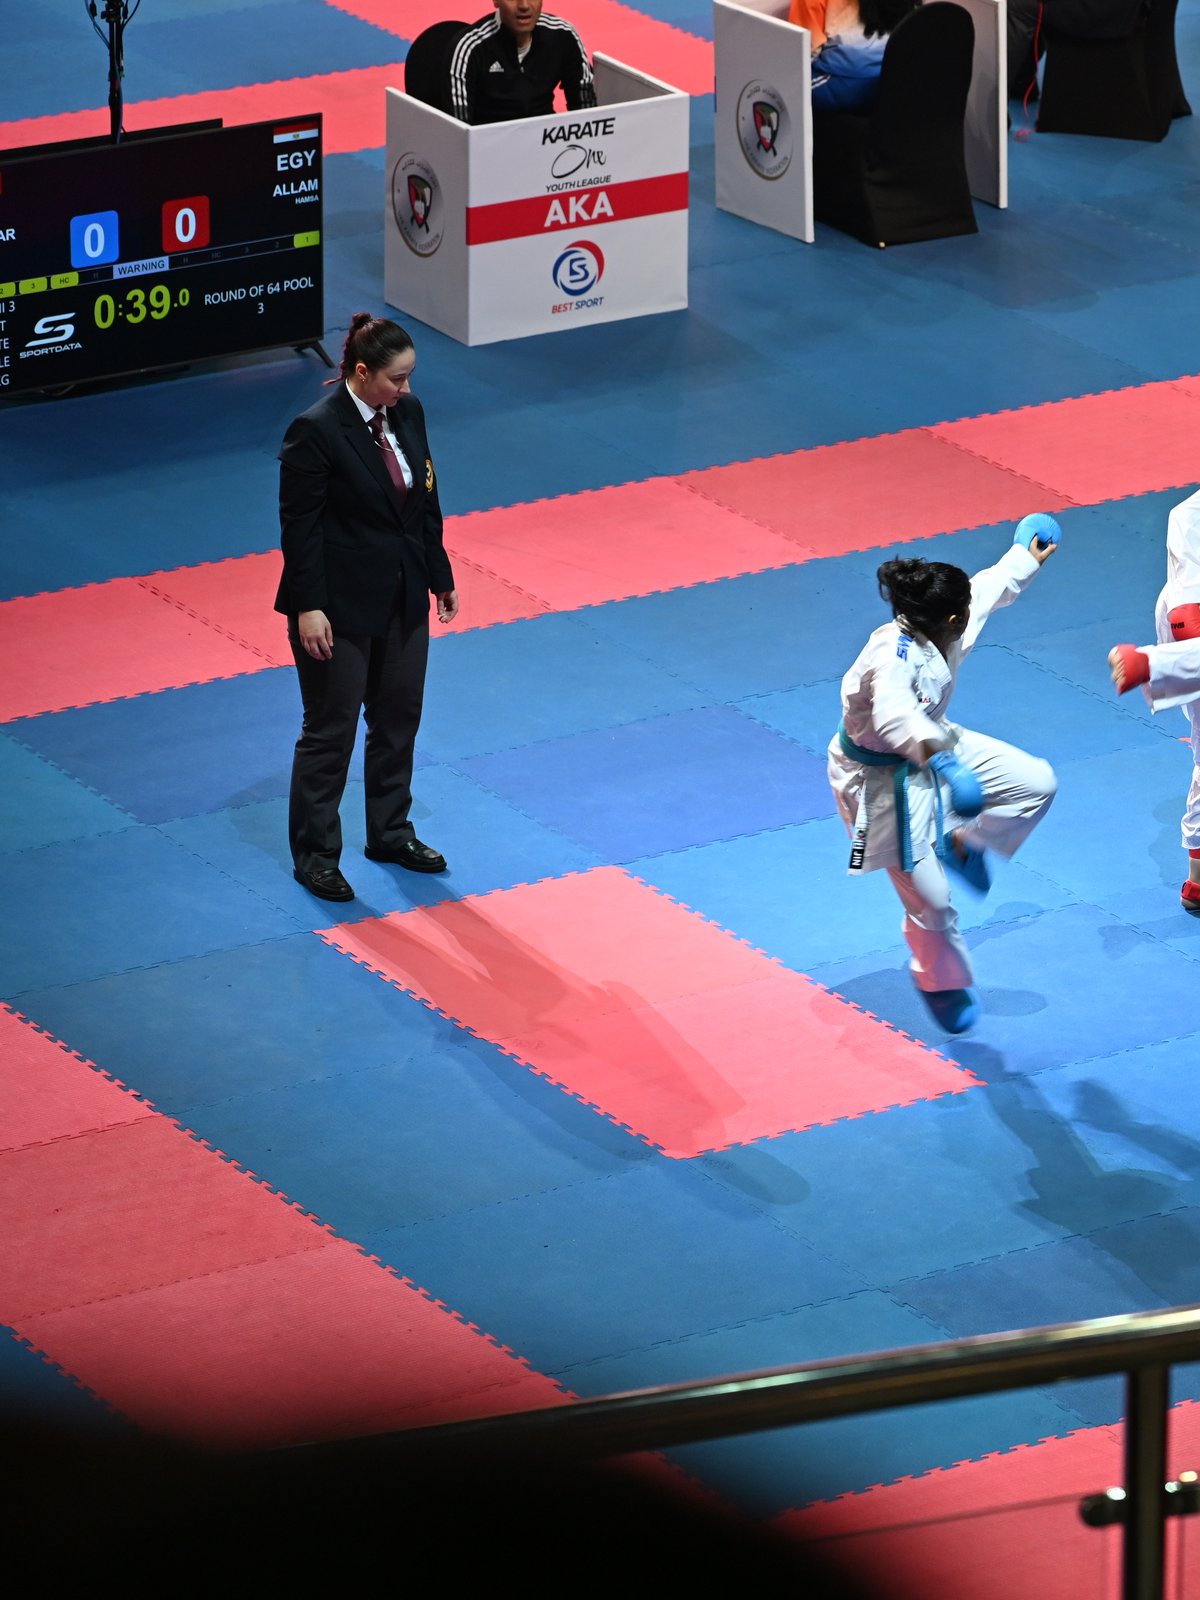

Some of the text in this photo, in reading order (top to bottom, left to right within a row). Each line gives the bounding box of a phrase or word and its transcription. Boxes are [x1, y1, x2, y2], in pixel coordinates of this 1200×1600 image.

[541, 117, 616, 146] KARATE
[277, 150, 316, 171] EGY
[551, 144, 607, 179] One
[273, 179, 318, 197] ALLAM
[546, 174, 612, 193] YOUTH LEAGUE
[543, 191, 615, 228] AKA
[175, 207, 196, 243] 0
[83, 222, 105, 258] 0
[117, 260, 165, 275] WARNING
[204, 276, 314, 305] ROUND OF 64 POOL
[8, 300, 16, 312] 3
[257, 302, 264, 314] 3
[551, 297, 604, 314] BEST SPORT
[19, 342, 83, 359] SPORTDATA
